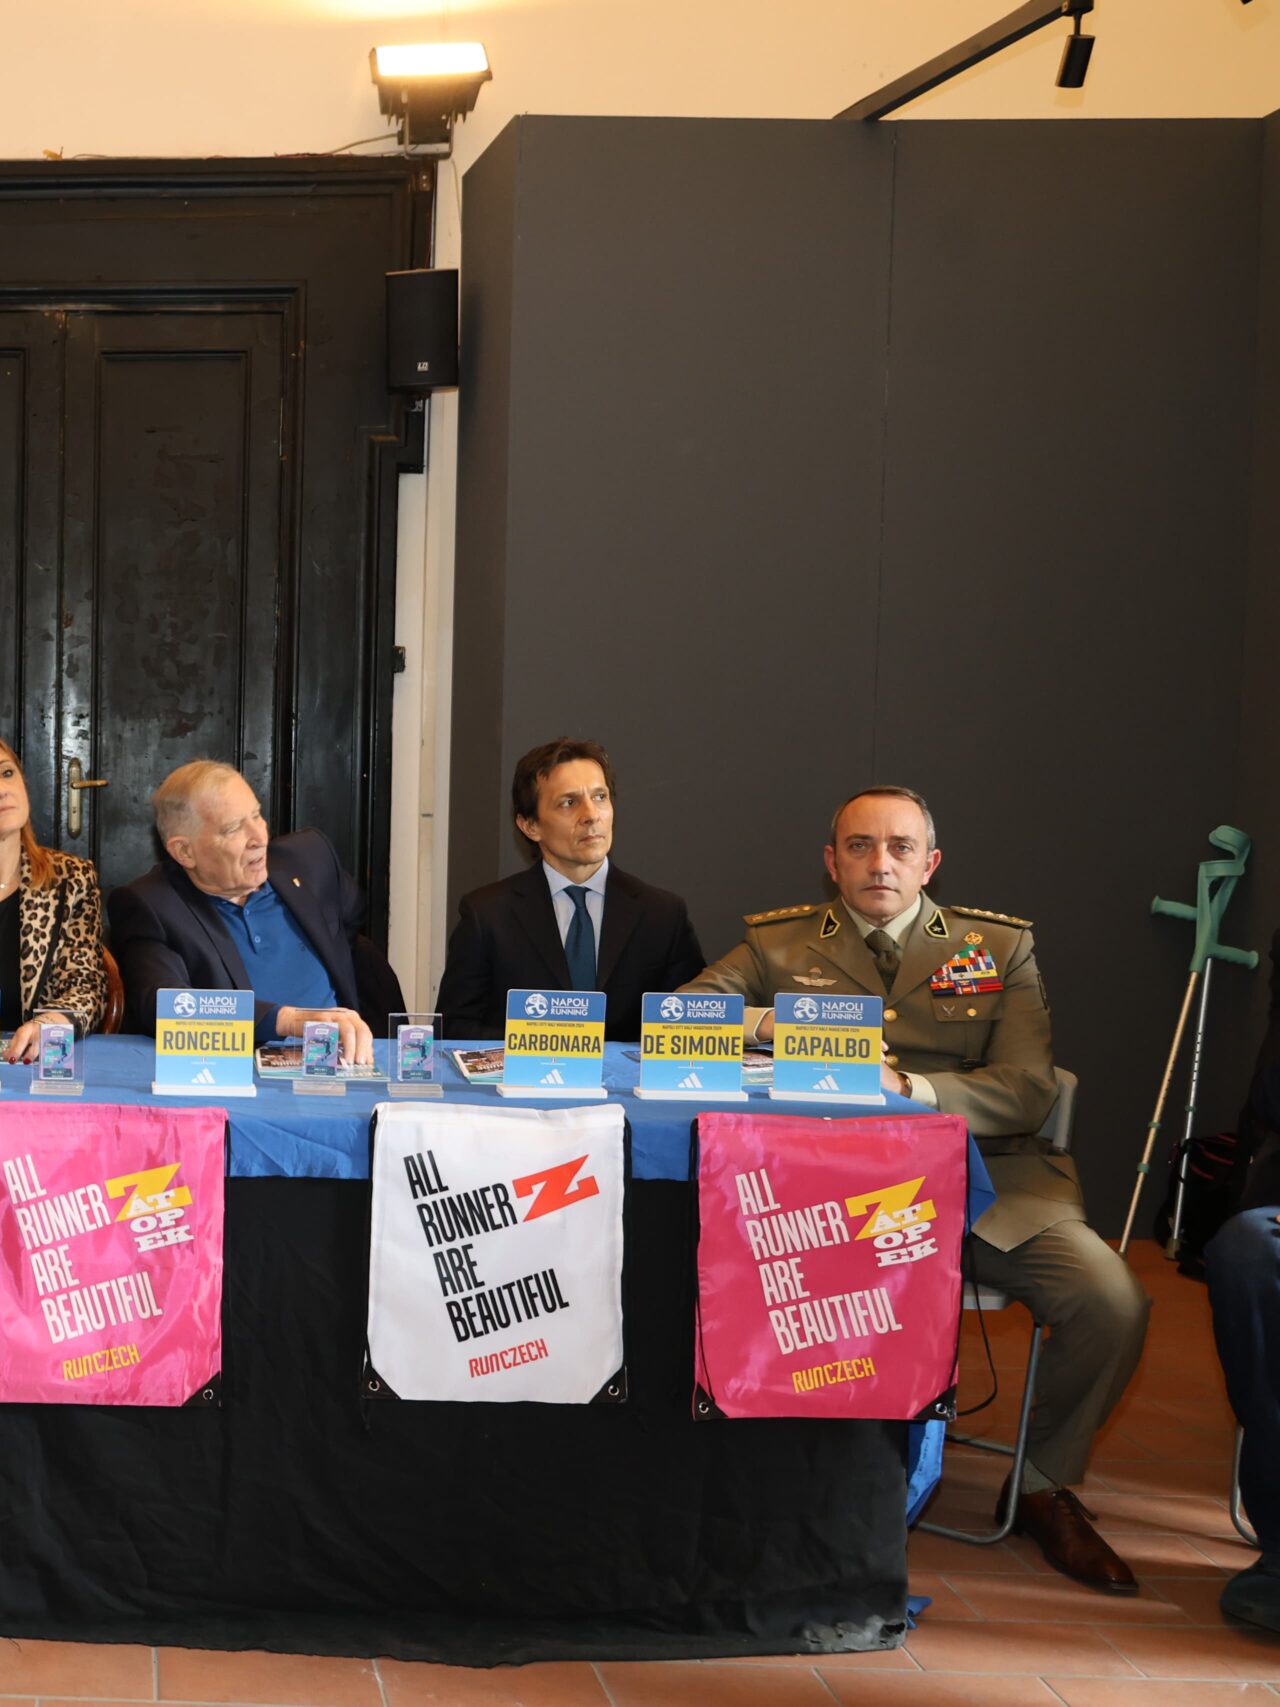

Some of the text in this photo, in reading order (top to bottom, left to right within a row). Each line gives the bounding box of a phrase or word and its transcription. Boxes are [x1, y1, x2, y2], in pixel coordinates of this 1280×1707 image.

[199, 1006, 237, 1015] RUNNING
[200, 996, 237, 1006] NAPOLI
[550, 1007, 588, 1017] RUNNING
[551, 997, 589, 1007] NAPOLI
[686, 1010, 726, 1019] RUNNING
[687, 1000, 726, 1010] NAPOLI
[821, 1001, 864, 1012] NAPOLI
[821, 1011, 863, 1021] RUNNING
[162, 1029, 246, 1052] RONCELLI
[507, 1032, 602, 1053] CARBONARA
[643, 1034, 741, 1056] DE SIMONE
[784, 1035, 870, 1059] CAPALBO
[2, 1154, 47, 1204] ALL
[403, 1150, 449, 1199] ALL
[735, 1168, 781, 1216] ALL
[15, 1183, 111, 1250] RUNNER
[416, 1182, 518, 1248] RUNNER
[745, 1200, 850, 1261] RUNNER
[30, 1244, 80, 1297] ARE
[433, 1243, 485, 1297] ARE
[758, 1257, 810, 1307] ARE
[40, 1271, 164, 1345] BEAUTIFUL
[445, 1268, 570, 1343] BEAUTIFUL
[768, 1286, 903, 1356] BEAUTIFUL
[63, 1344, 141, 1381] RUNCZECH
[469, 1338, 549, 1379] RUNCZECH
[791, 1356, 876, 1394] RUNCZECH
